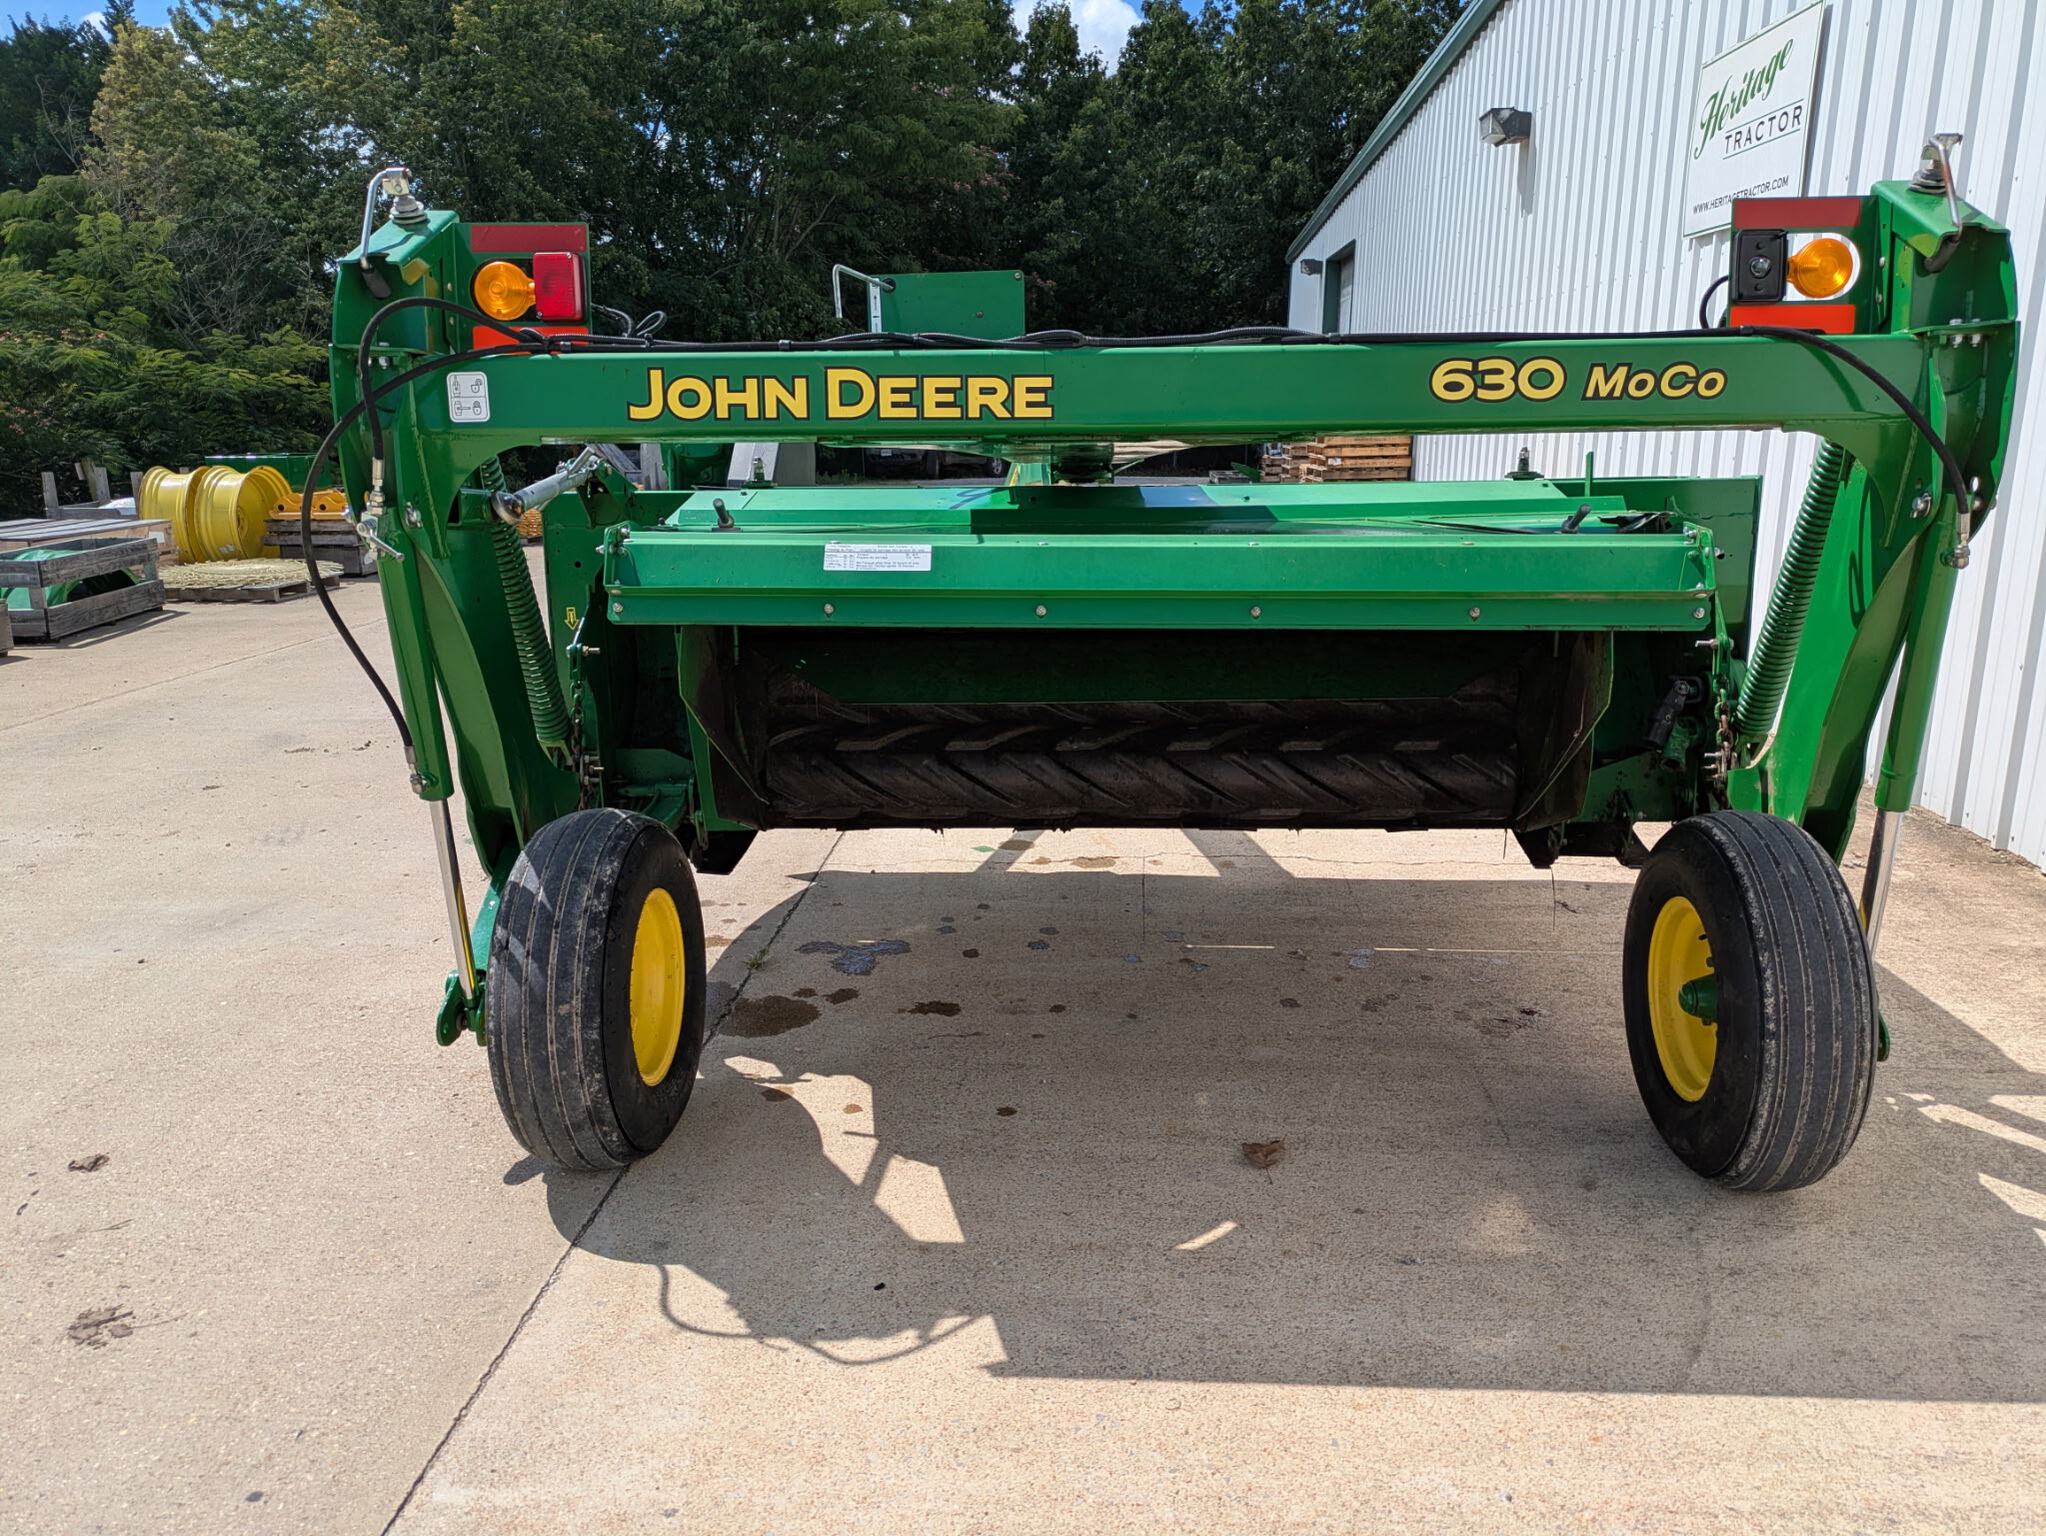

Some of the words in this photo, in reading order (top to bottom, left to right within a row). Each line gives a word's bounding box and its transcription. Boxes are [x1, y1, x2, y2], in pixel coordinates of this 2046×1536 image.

[1694, 38, 1793, 160] Heritage
[1724, 104, 1803, 154] TRACTOR
[627, 367, 809, 420] JOHN
[824, 366, 1055, 420] DEERE
[1429, 356, 1567, 403] 630
[1581, 361, 1728, 401] MoCo
